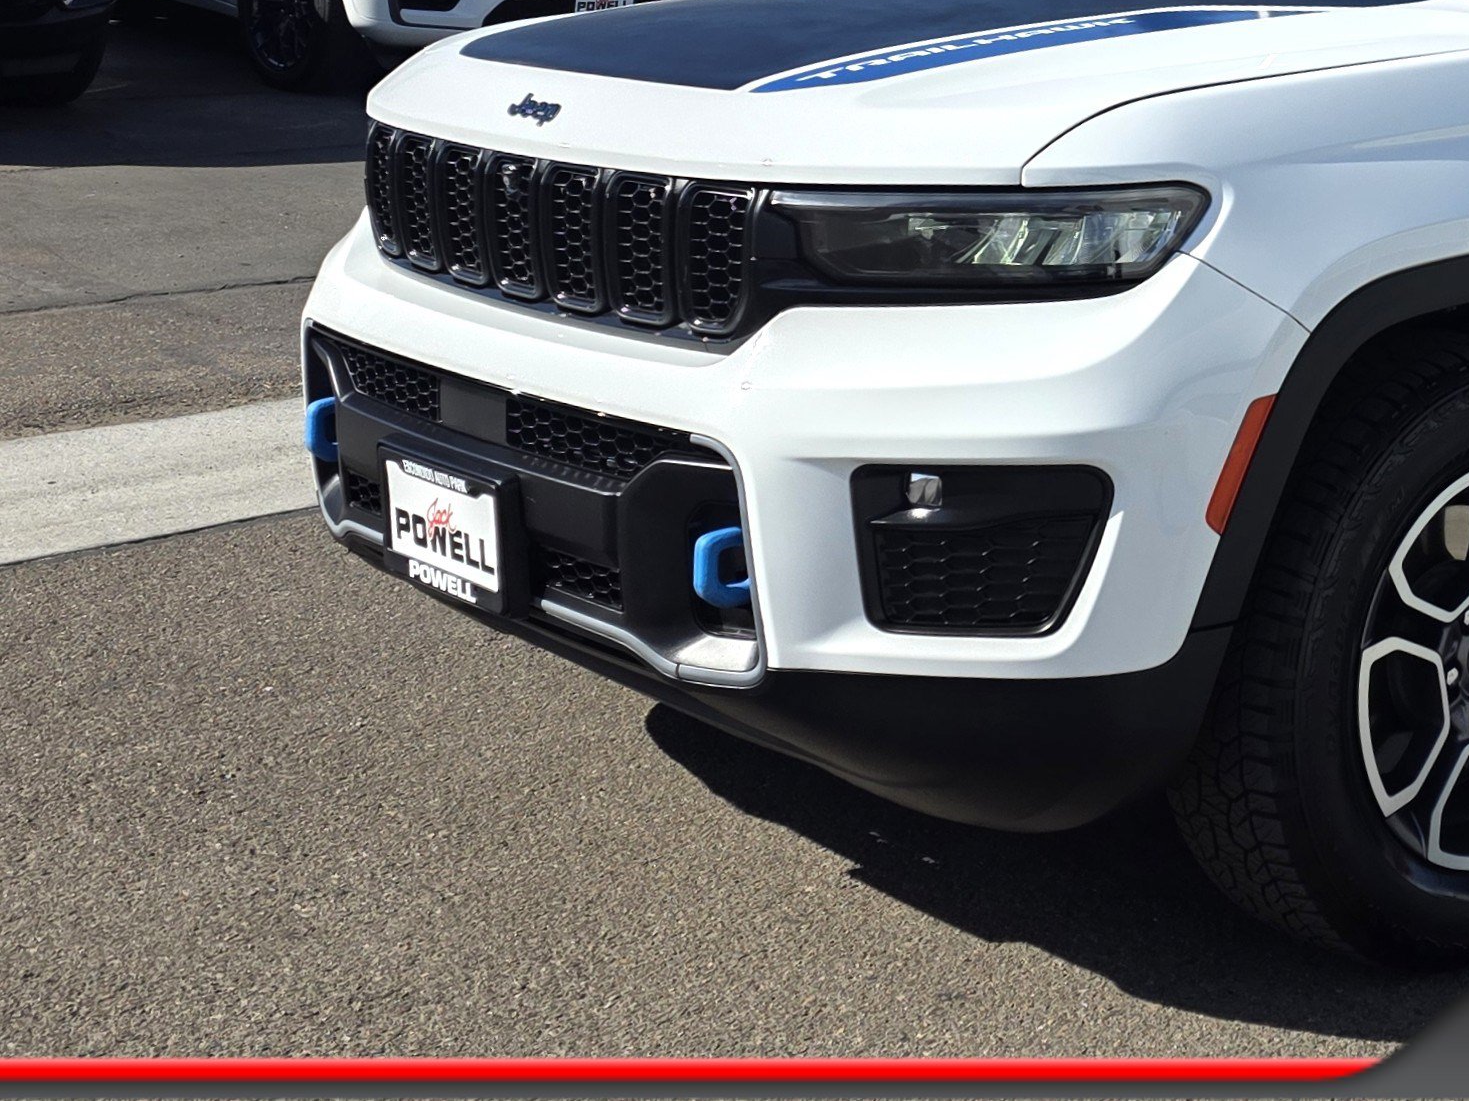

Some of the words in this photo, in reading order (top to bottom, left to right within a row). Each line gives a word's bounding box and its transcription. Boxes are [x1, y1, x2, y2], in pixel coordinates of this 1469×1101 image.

[796, 16, 1137, 82] TRAILHAWK
[507, 92, 563, 127] Jeep
[395, 506, 496, 576] POWELL
[408, 559, 478, 604] POWELL
